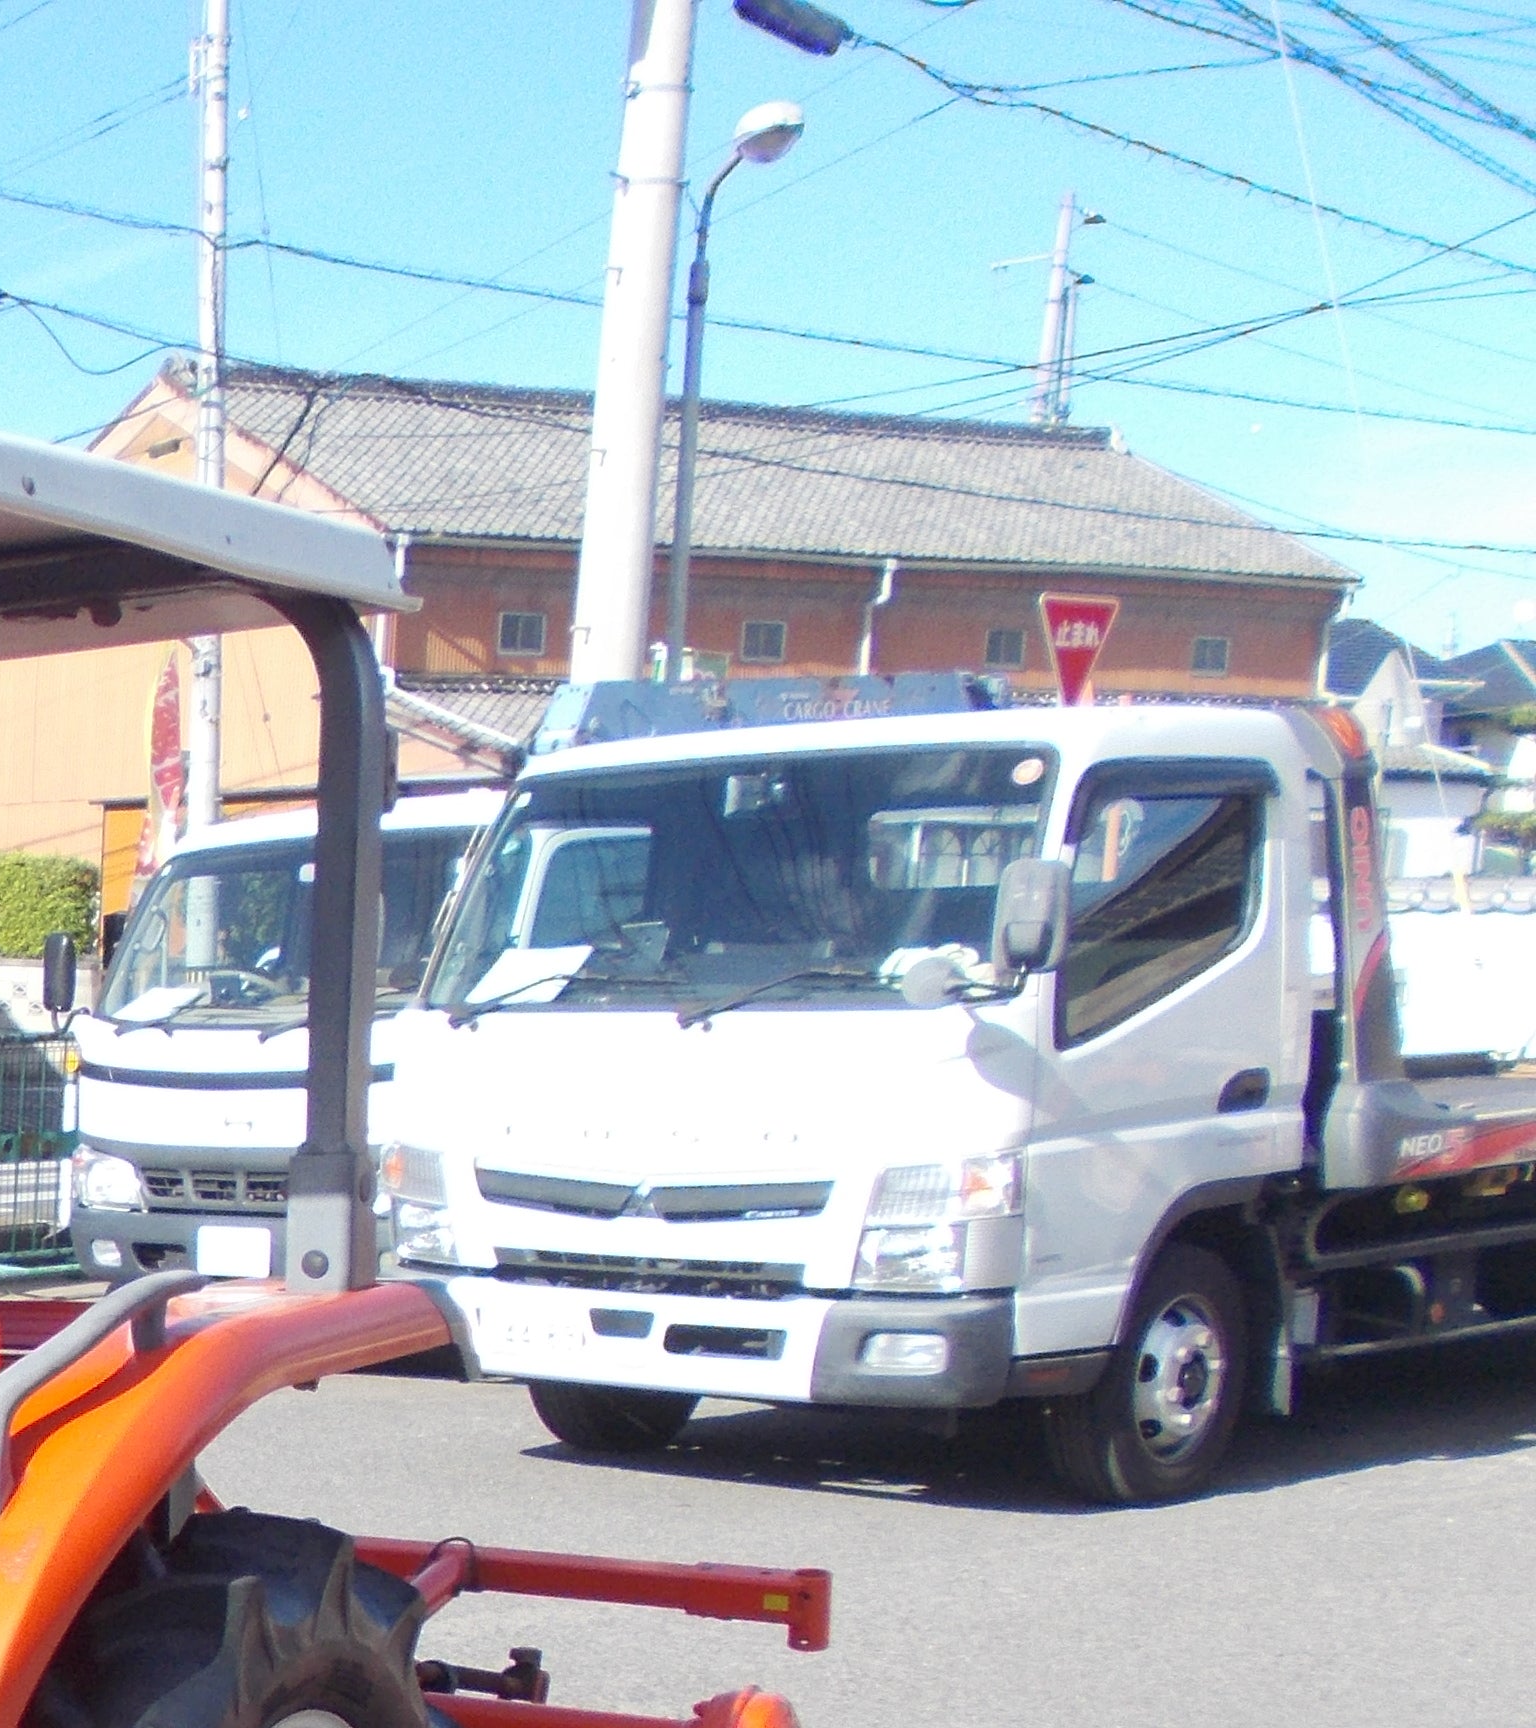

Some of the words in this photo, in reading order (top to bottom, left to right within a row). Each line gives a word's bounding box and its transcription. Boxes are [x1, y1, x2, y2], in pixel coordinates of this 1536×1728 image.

[1056, 619, 1099, 648] 止まれ
[783, 701, 835, 721] CARGO
[843, 698, 891, 719] CRANE
[1349, 805, 1373, 932] UNIC
